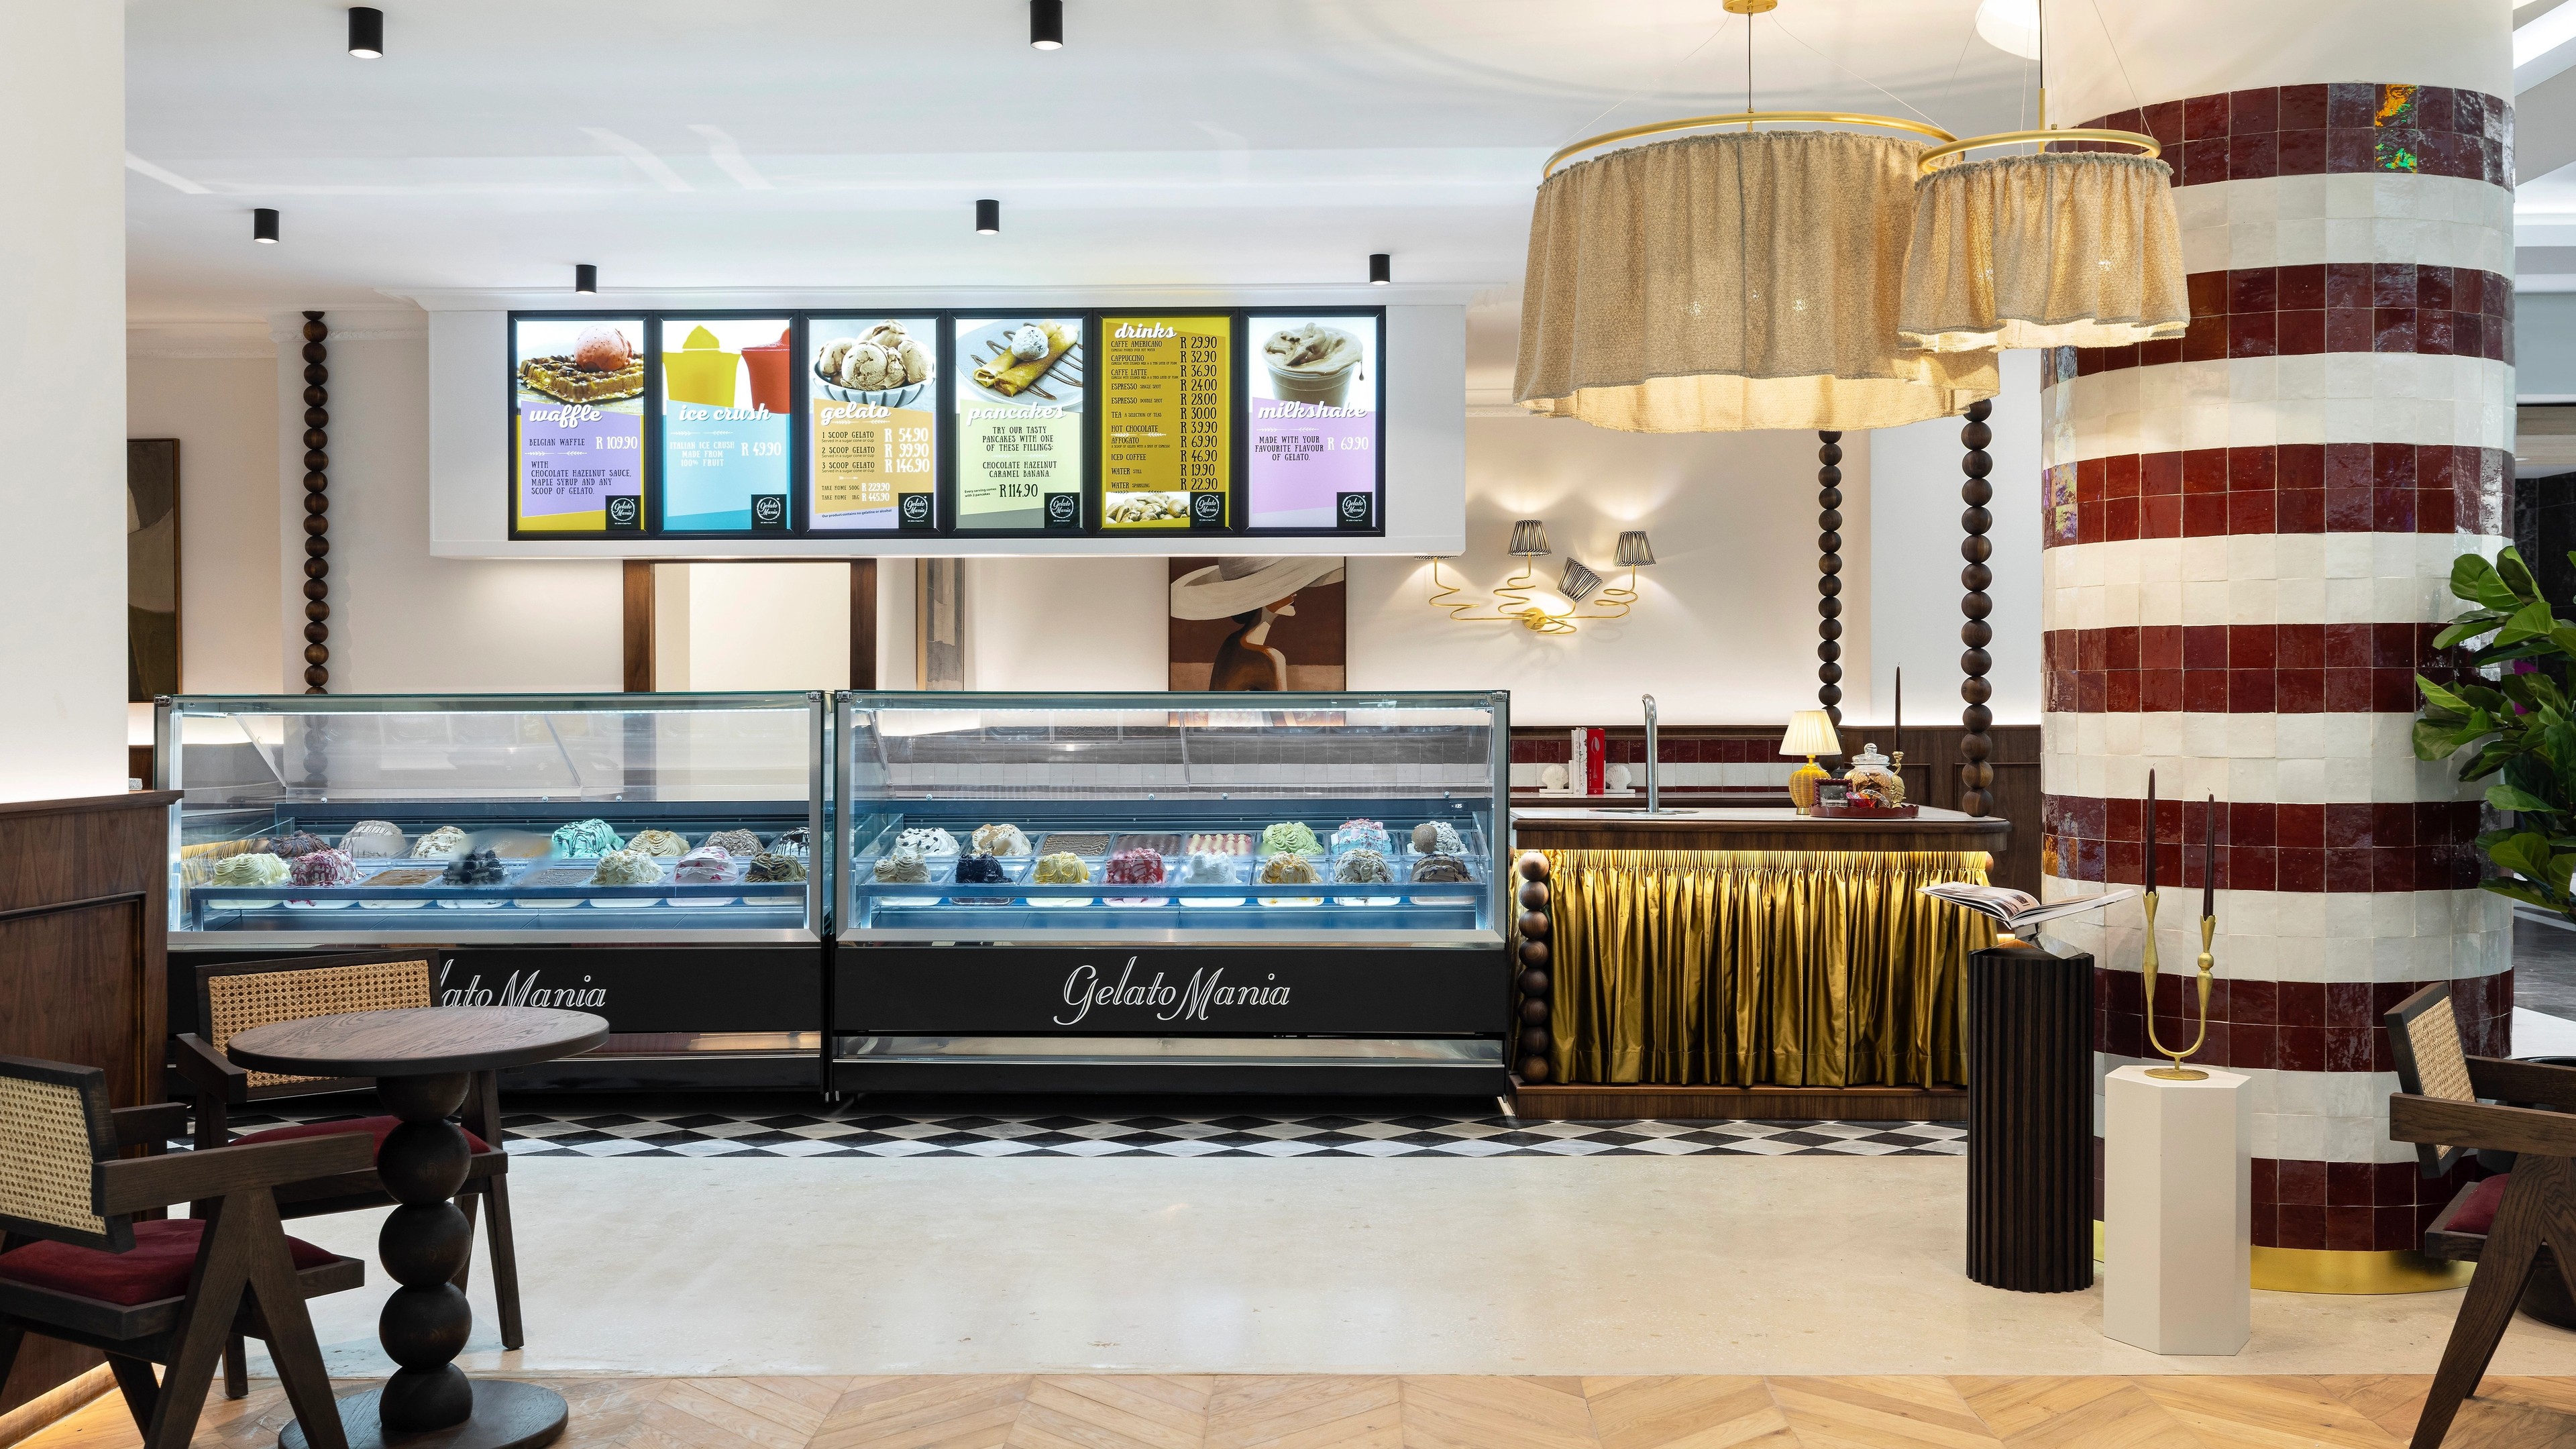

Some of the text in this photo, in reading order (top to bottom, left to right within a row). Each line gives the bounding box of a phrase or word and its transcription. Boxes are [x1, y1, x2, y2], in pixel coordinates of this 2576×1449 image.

[1115, 322, 1177, 339] drinks
[1181, 337, 1217, 349] R 29.90
[1181, 351, 1217, 363] R 32.90
[1181, 365, 1217, 377] R 36.90
[1181, 379, 1217, 391] R 24.00
[1181, 393, 1217, 405] R 28.00
[679, 403, 771, 421] ice crush
[820, 401, 892, 426] gelato
[966, 402, 1067, 426] pancakes
[1181, 407, 1216, 419] R 30.00
[1258, 401, 1367, 419] milkshake
[529, 405, 602, 428] waffle
[1181, 421, 1218, 433] R 39.90
[884, 427, 928, 442] R 54.90
[596, 437, 637, 449] R 109.90
[1181, 435, 1218, 447] R 69.90
[1327, 437, 1368, 450] R 69.90
[741, 442, 782, 456] R 49.90
[885, 443, 929, 458] R 99.90
[1181, 450, 1217, 462] R 46.90
[885, 459, 930, 472] R 146.90
[1181, 464, 1215, 476] R 19.90
[862, 483, 867, 491] R
[869, 483, 890, 491] 229.90
[1181, 478, 1218, 490] R 22.90
[1000, 484, 1038, 497] R 114.90
[862, 493, 867, 501] R
[869, 493, 890, 501] 445.90
[613, 501, 632, 513] Gelato
[441, 959, 606, 1007] lato Mania
[1053, 956, 1290, 1025] Gelato Mania
